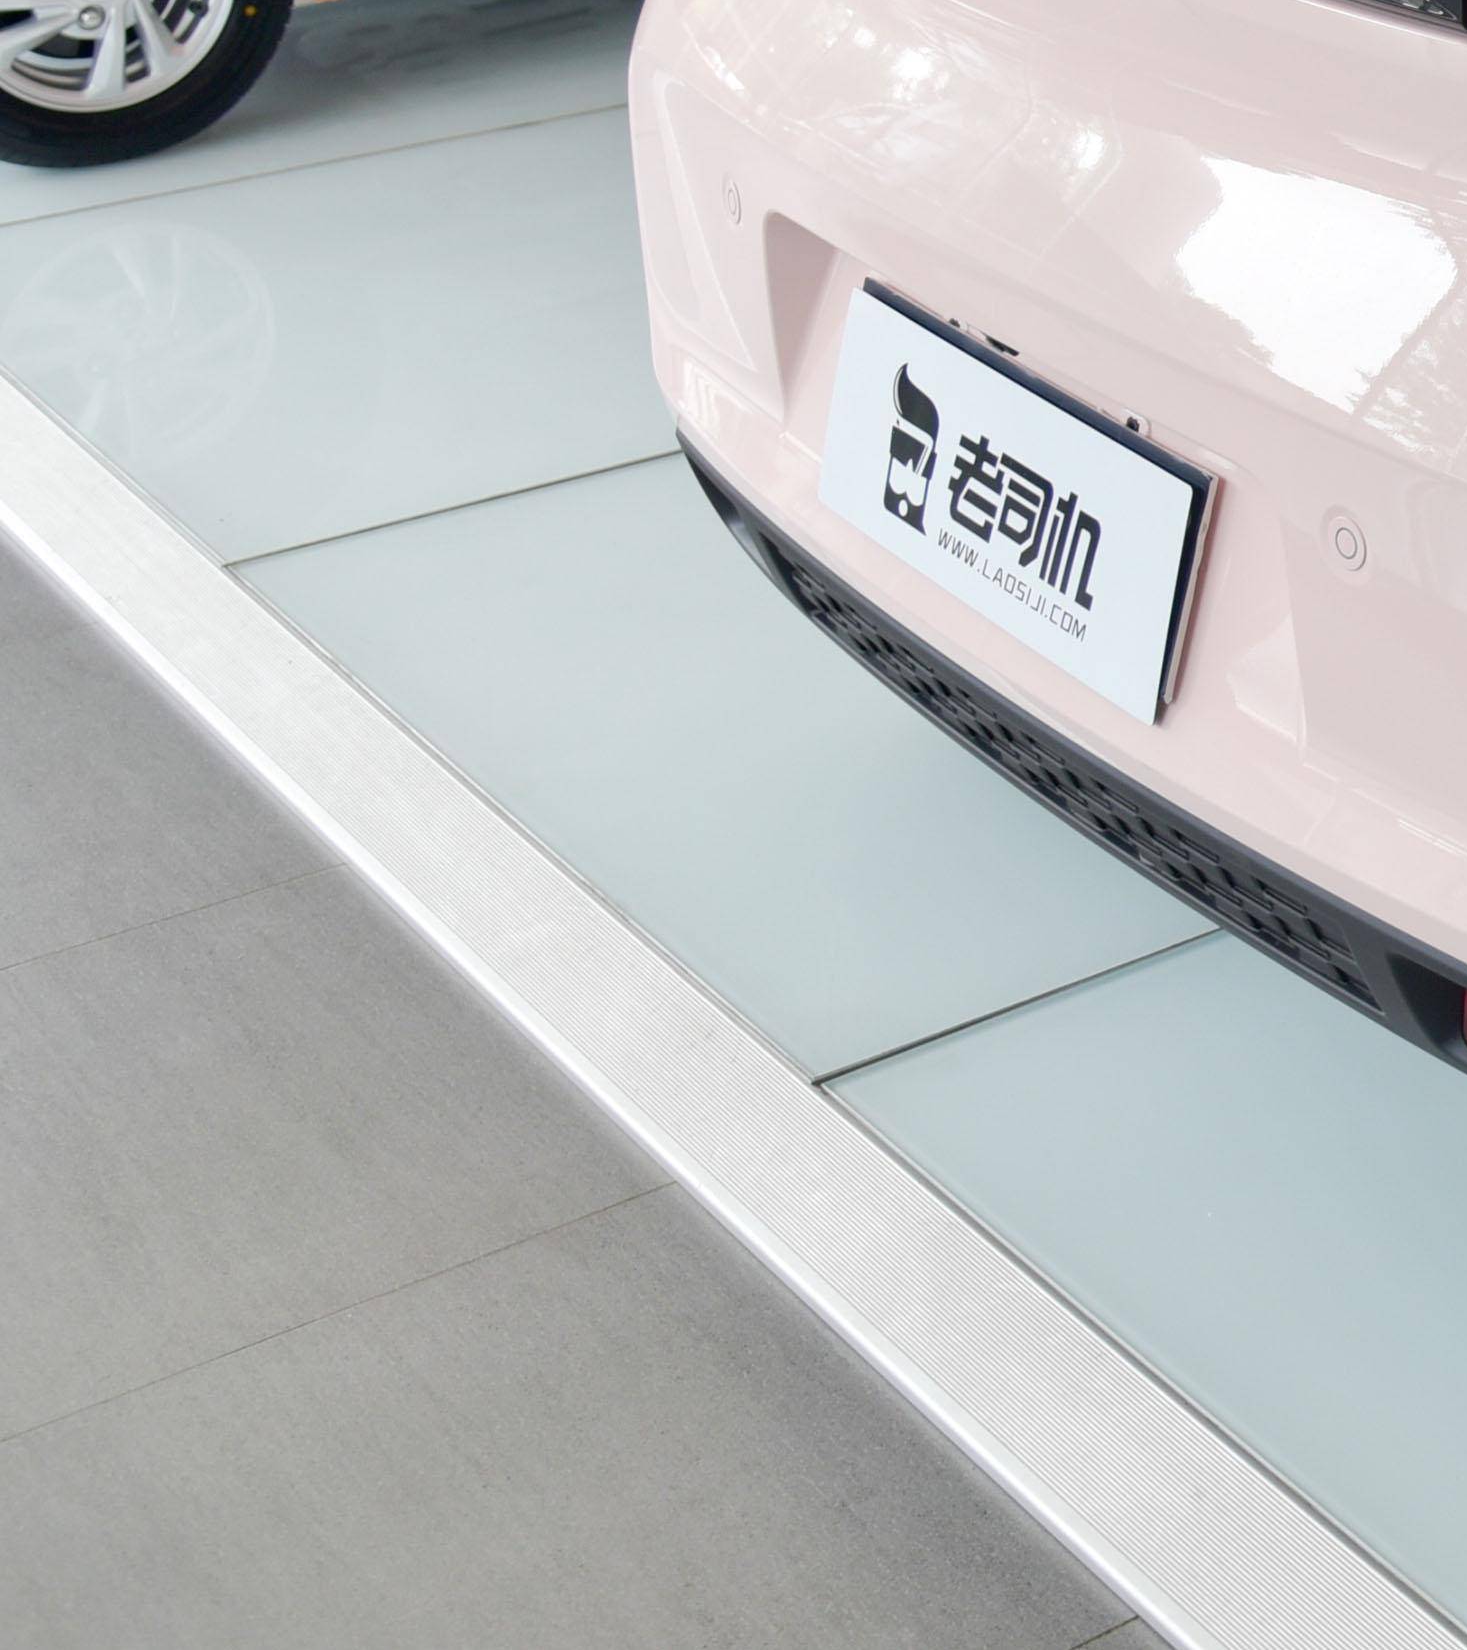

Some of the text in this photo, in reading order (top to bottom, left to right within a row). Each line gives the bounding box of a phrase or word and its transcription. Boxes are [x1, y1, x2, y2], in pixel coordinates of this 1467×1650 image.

[936, 527, 1088, 643] WWW.LAOSIJI.COM
[947, 433, 1102, 612] 老司机
